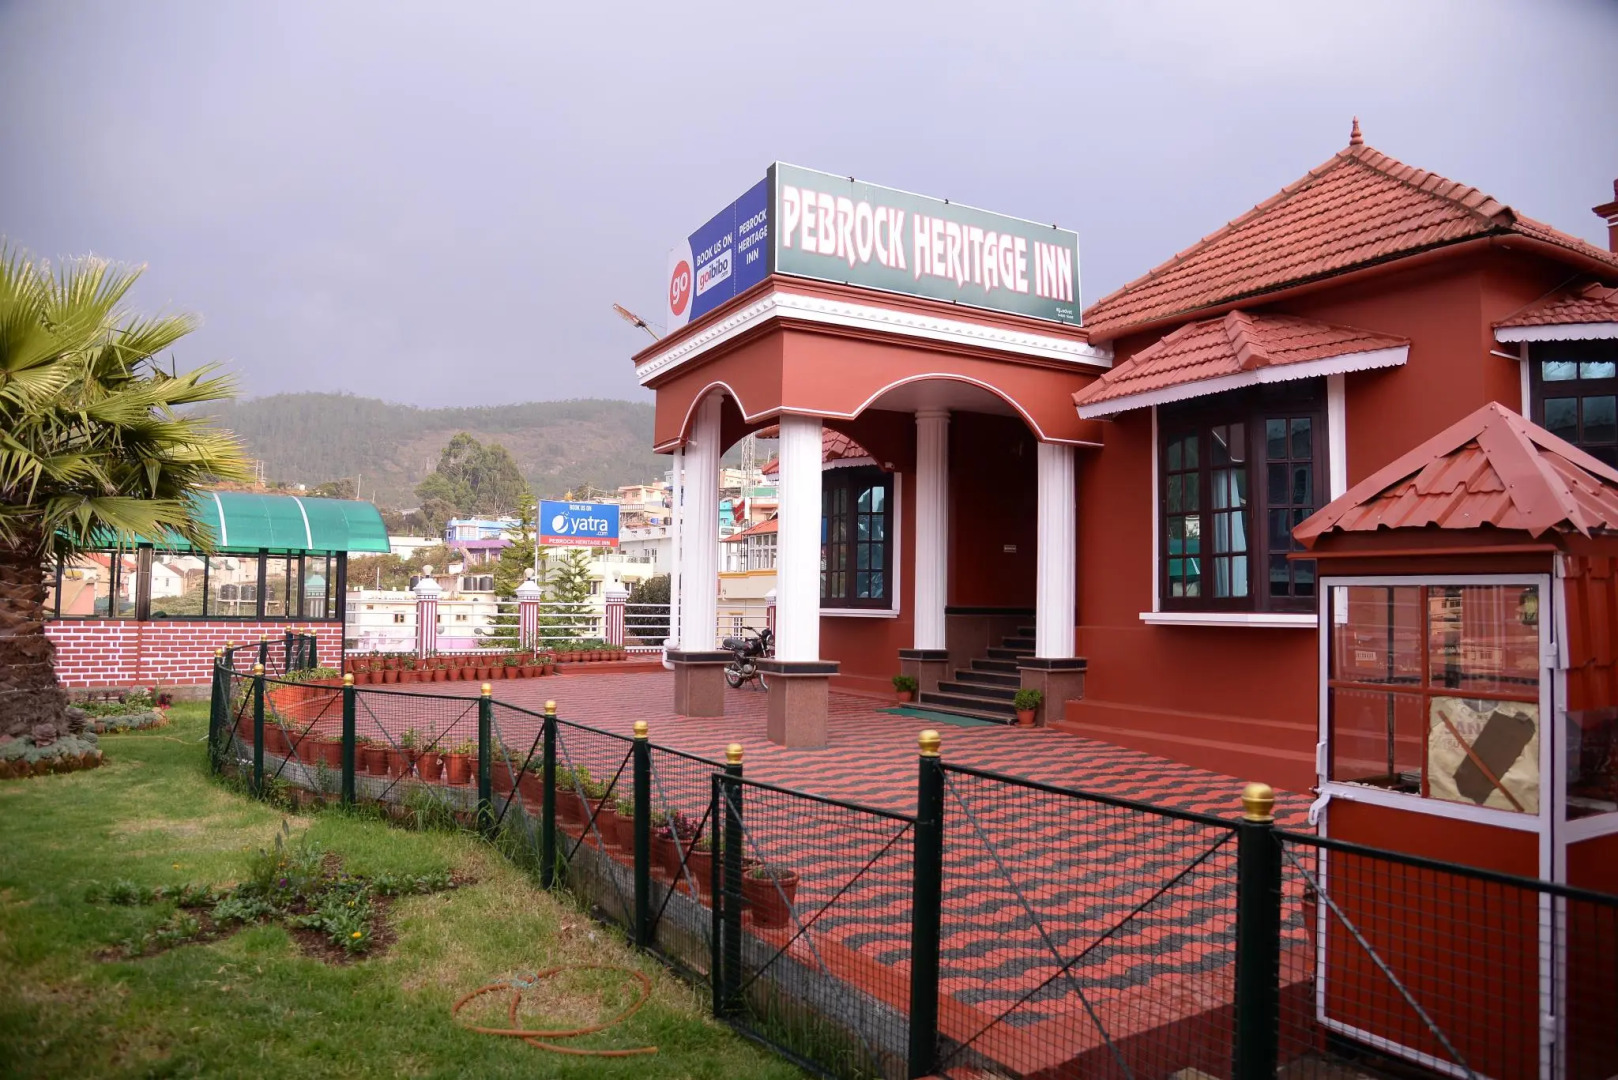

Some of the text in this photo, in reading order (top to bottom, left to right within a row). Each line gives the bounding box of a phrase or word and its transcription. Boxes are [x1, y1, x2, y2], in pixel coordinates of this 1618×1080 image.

[739, 208, 767, 237] PEBROCK
[697, 232, 733, 267] BOOK US ON
[738, 224, 768, 254] HERITAGE
[783, 184, 1074, 303] PEBROCK HERITAGE INN
[746, 248, 759, 265] INN
[672, 272, 688, 305] go
[700, 258, 728, 290] goibibo
[570, 516, 608, 534] yatra
